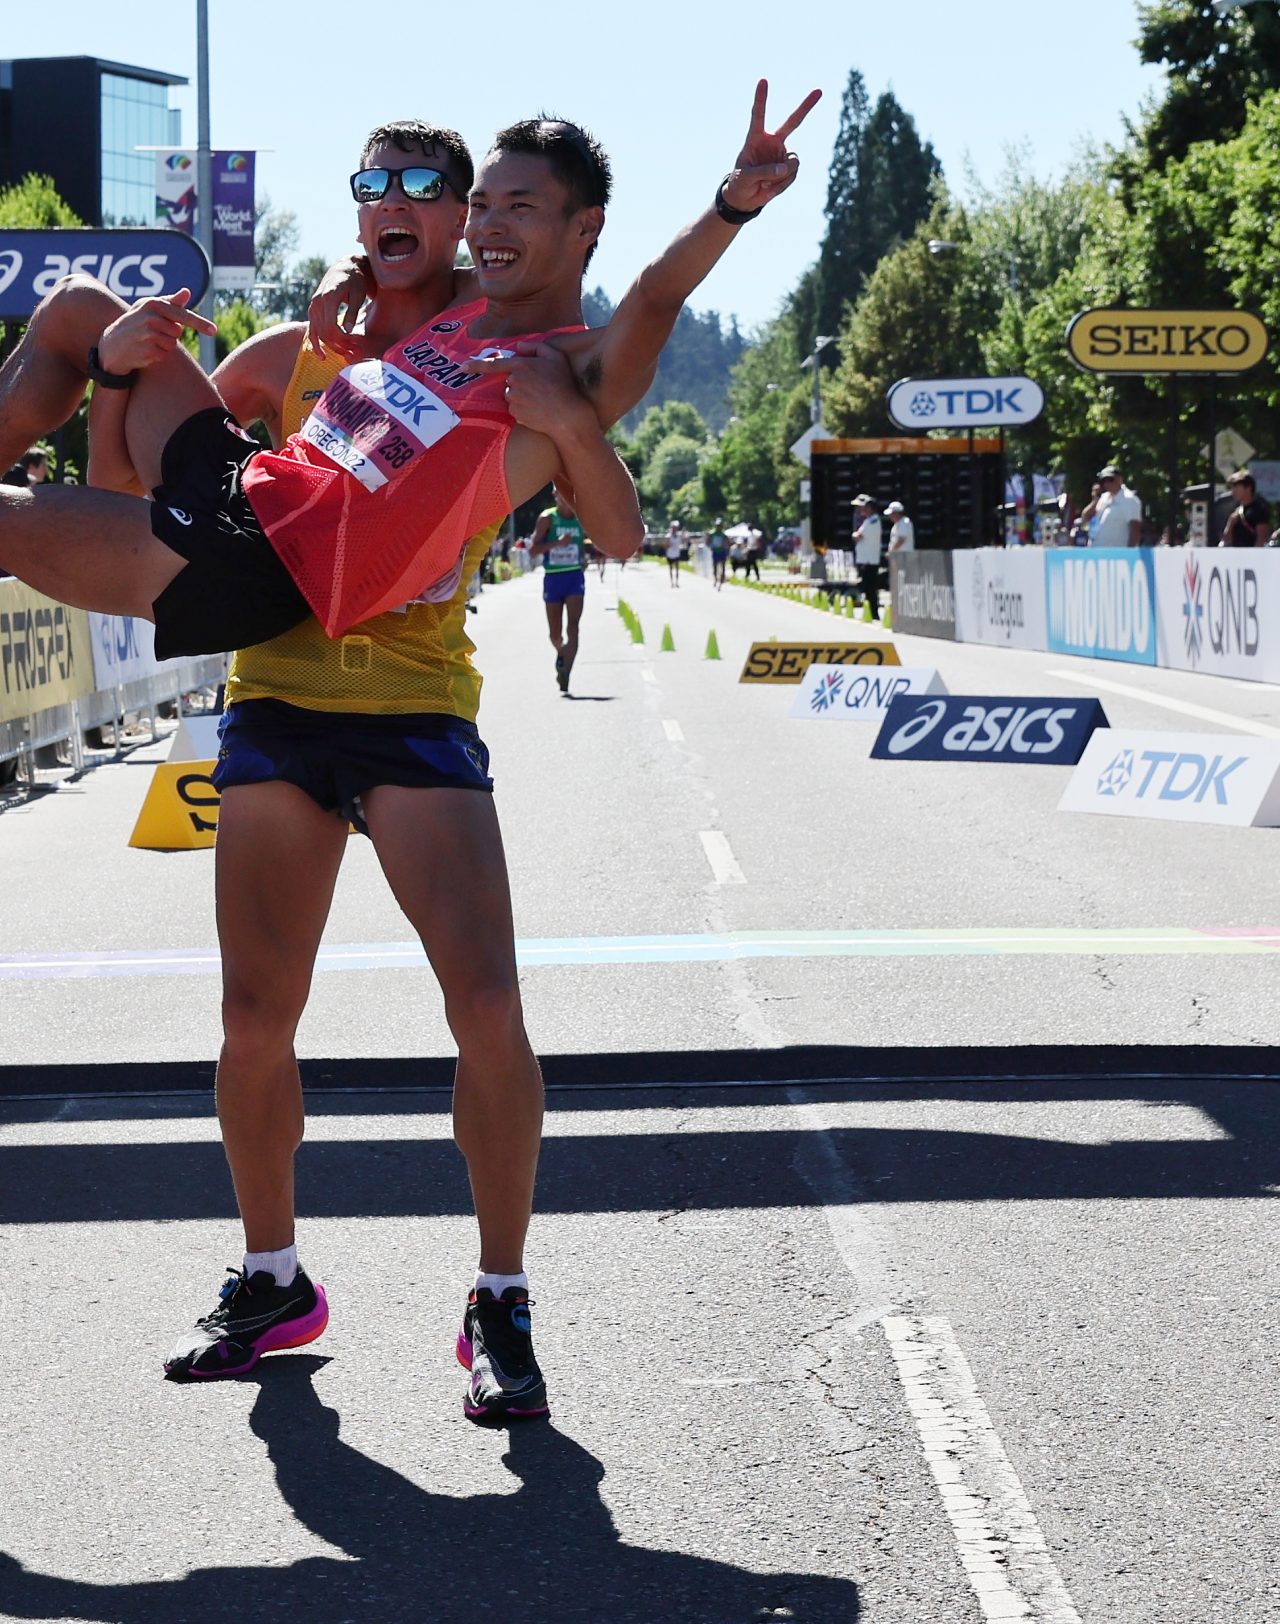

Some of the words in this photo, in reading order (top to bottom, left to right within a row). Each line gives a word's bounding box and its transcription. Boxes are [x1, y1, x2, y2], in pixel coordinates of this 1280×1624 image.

[1090, 325, 1251, 356] SEIKO
[403, 341, 481, 390] JAPAN
[384, 373, 438, 426] TDK
[937, 388, 1024, 415] TDK
[307, 424, 366, 472] OREGON22
[378, 436, 415, 469] 258
[1064, 559, 1150, 654] MONDO
[1208, 566, 1259, 656] QNB
[942, 706, 1077, 754] asics
[1135, 751, 1250, 806] TDK
